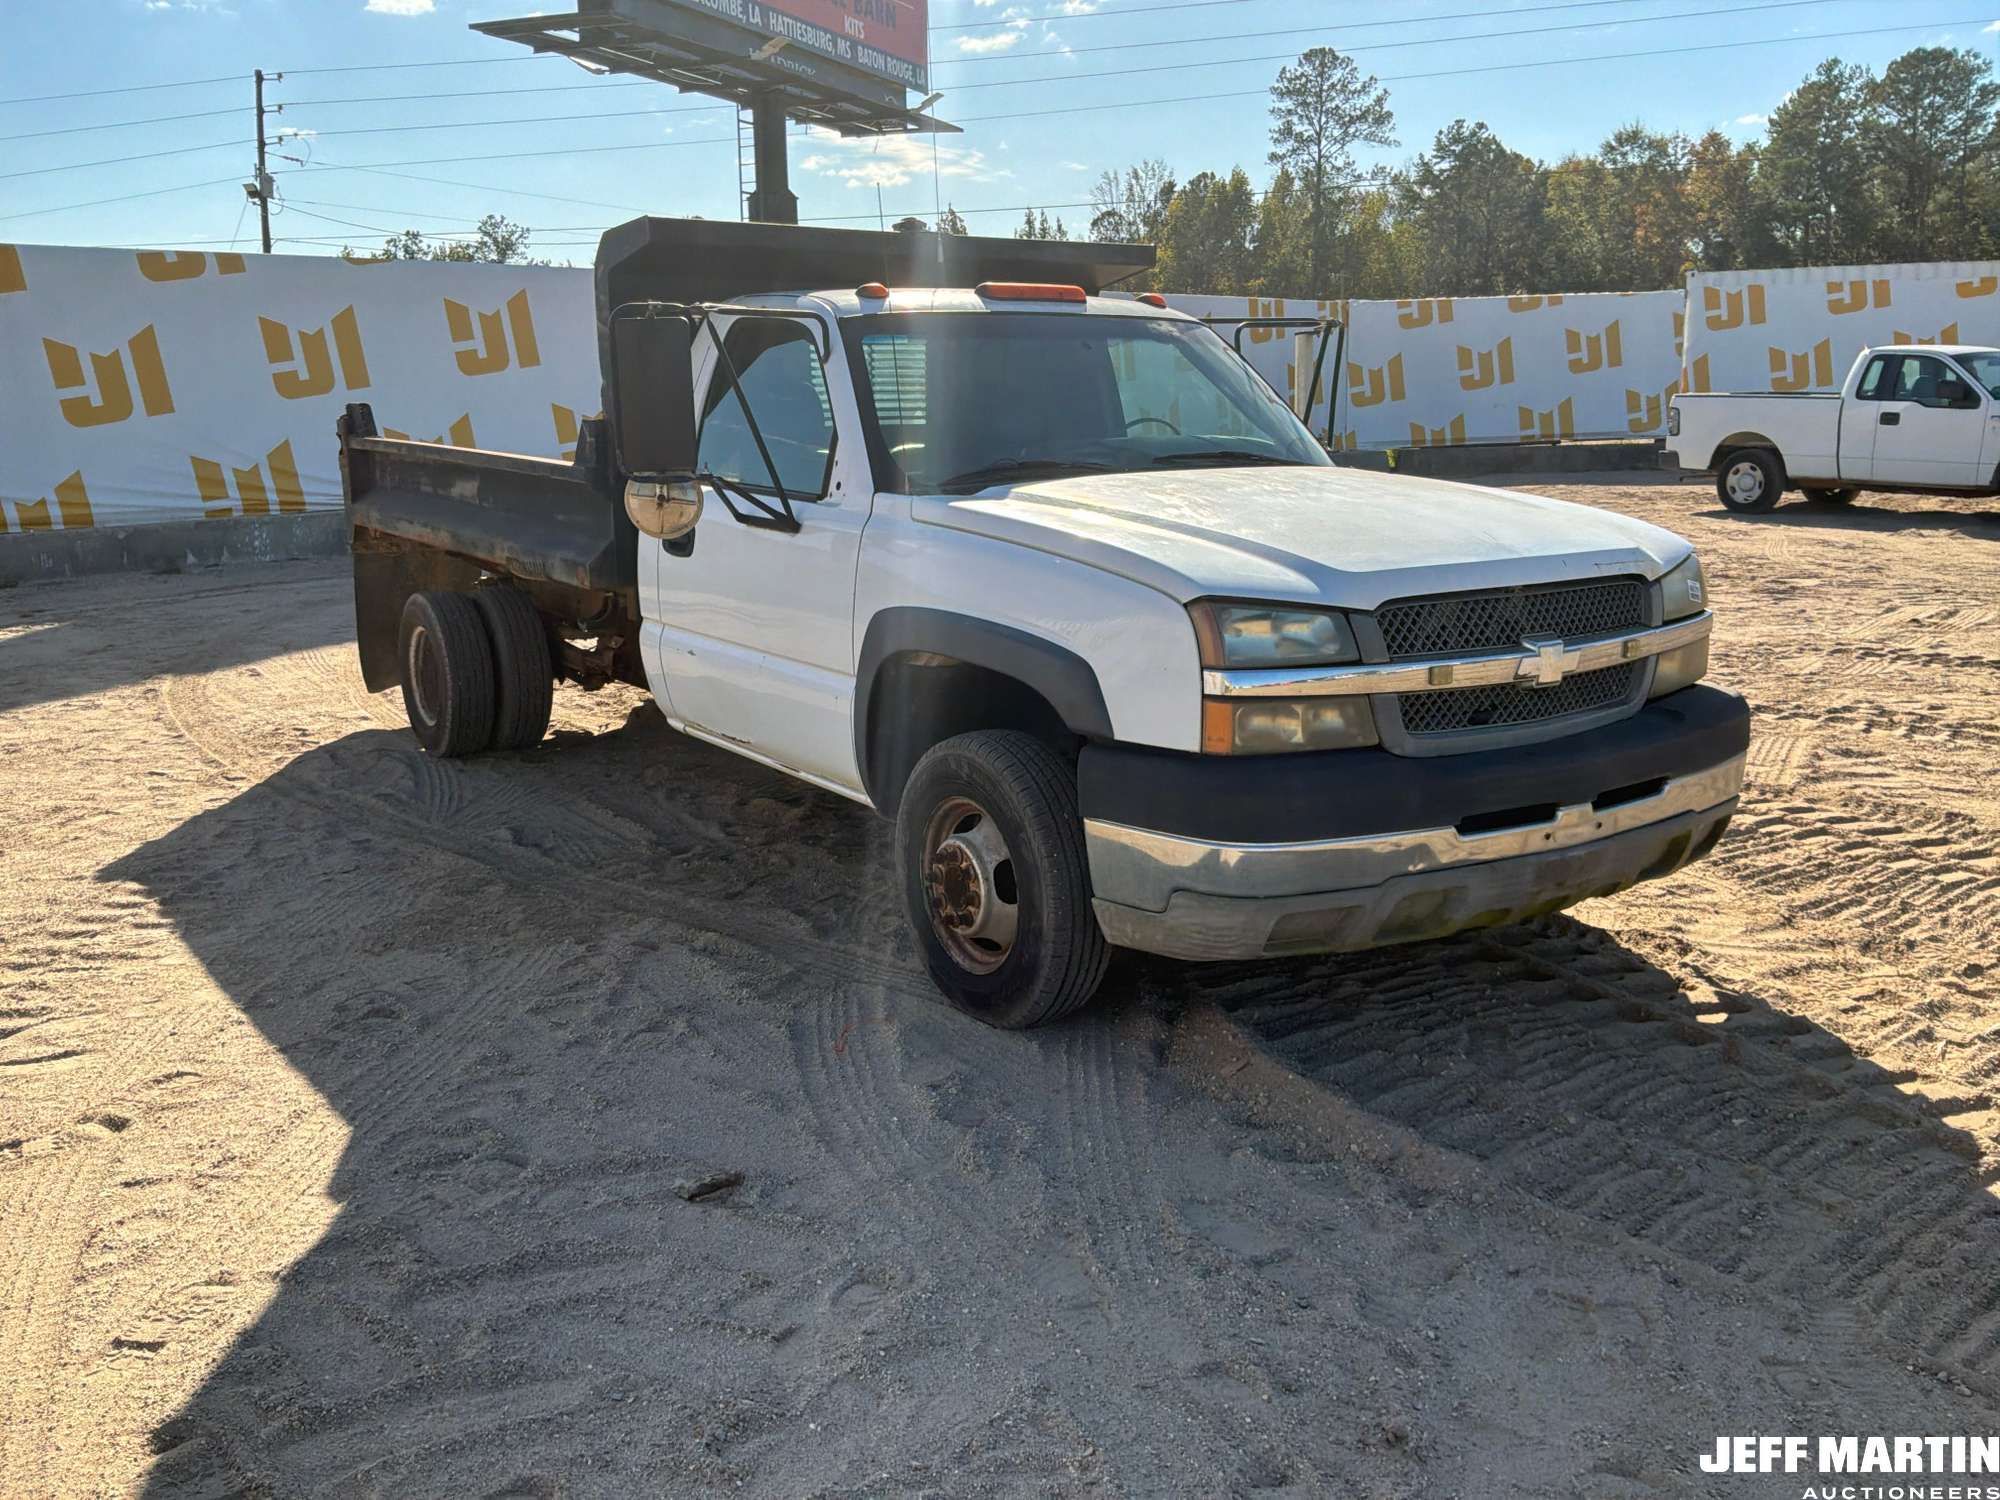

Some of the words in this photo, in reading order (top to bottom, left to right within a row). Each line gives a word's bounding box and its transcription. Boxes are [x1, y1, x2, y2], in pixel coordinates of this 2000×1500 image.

[749, 3, 762, 26] LA
[769, 11, 835, 55] HATTIESBURG,
[837, 38, 851, 58] MS
[857, 47, 886, 71] BATON
[844, 15, 865, 39] KITS
